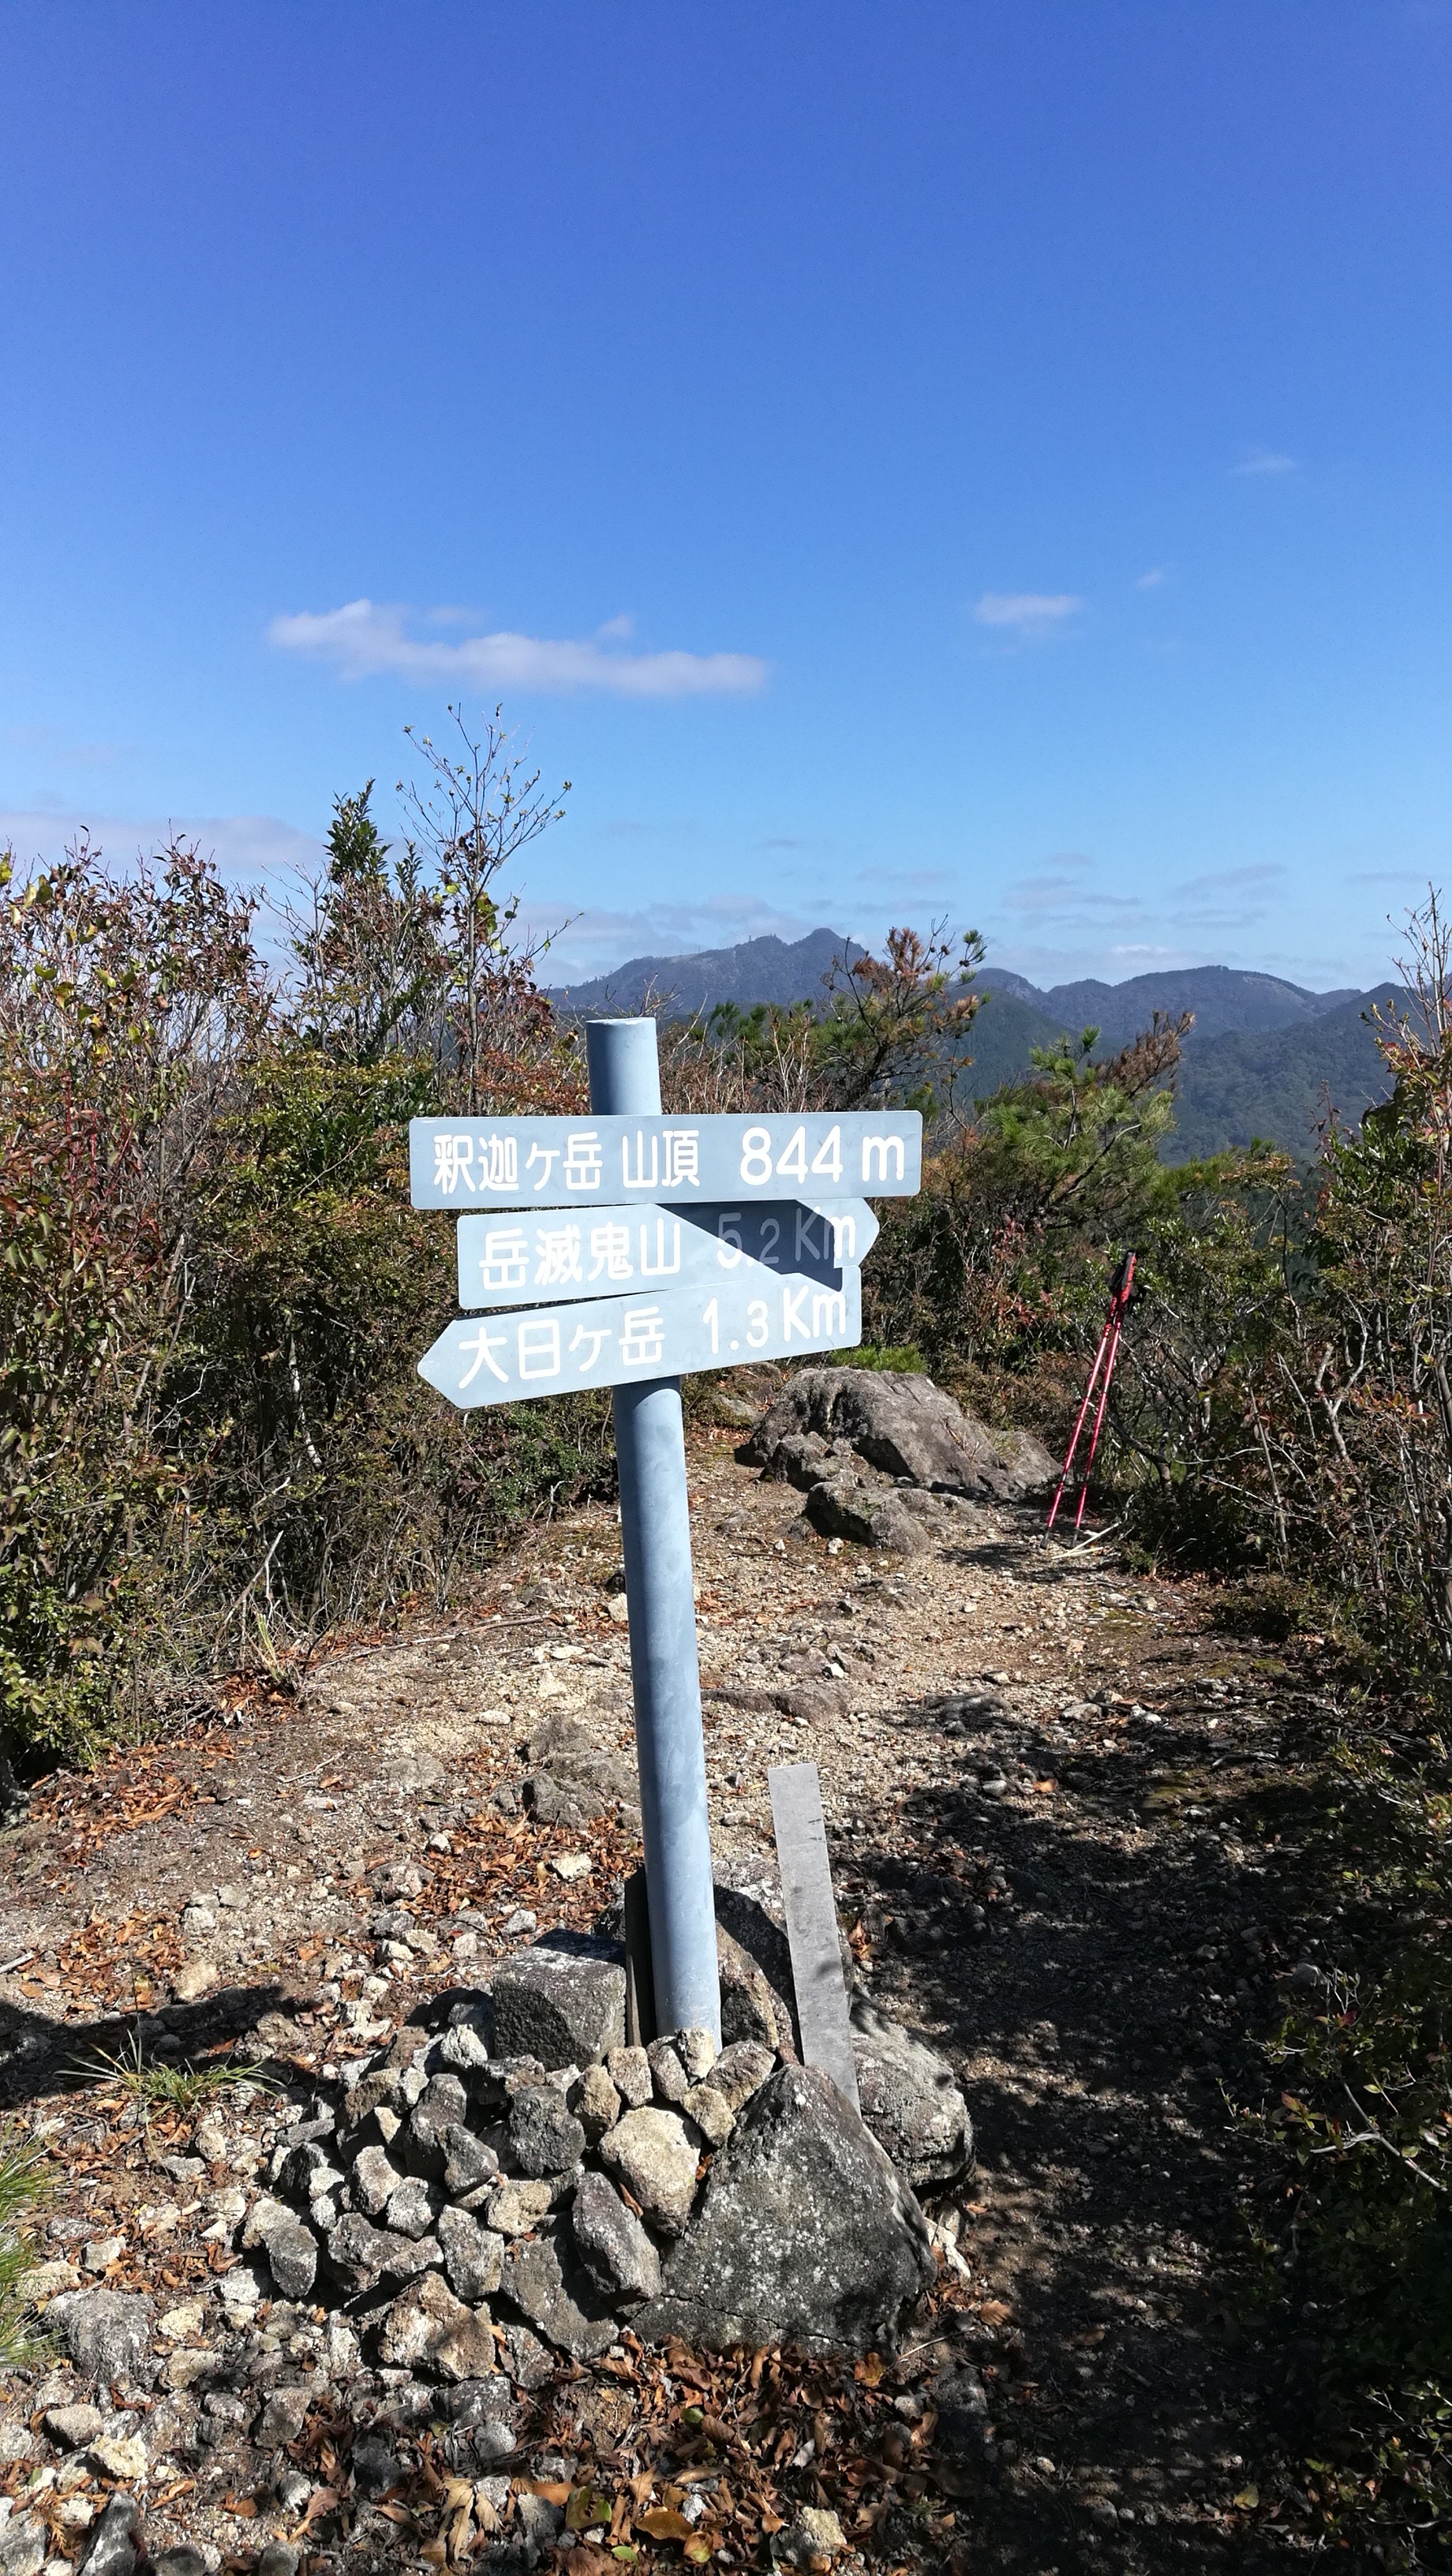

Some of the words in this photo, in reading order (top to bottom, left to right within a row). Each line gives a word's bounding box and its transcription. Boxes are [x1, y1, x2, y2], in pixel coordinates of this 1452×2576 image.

[622, 1130, 700, 1188] 山頂
[740, 1125, 842, 1185] 844
[862, 1136, 904, 1182] m
[479, 1219, 681, 1290] 岳滅鬼山
[717, 1213, 780, 1269] 5.2
[795, 1206, 855, 1260] Km
[703, 1298, 769, 1354] 1.3
[784, 1286, 845, 1342] Km
